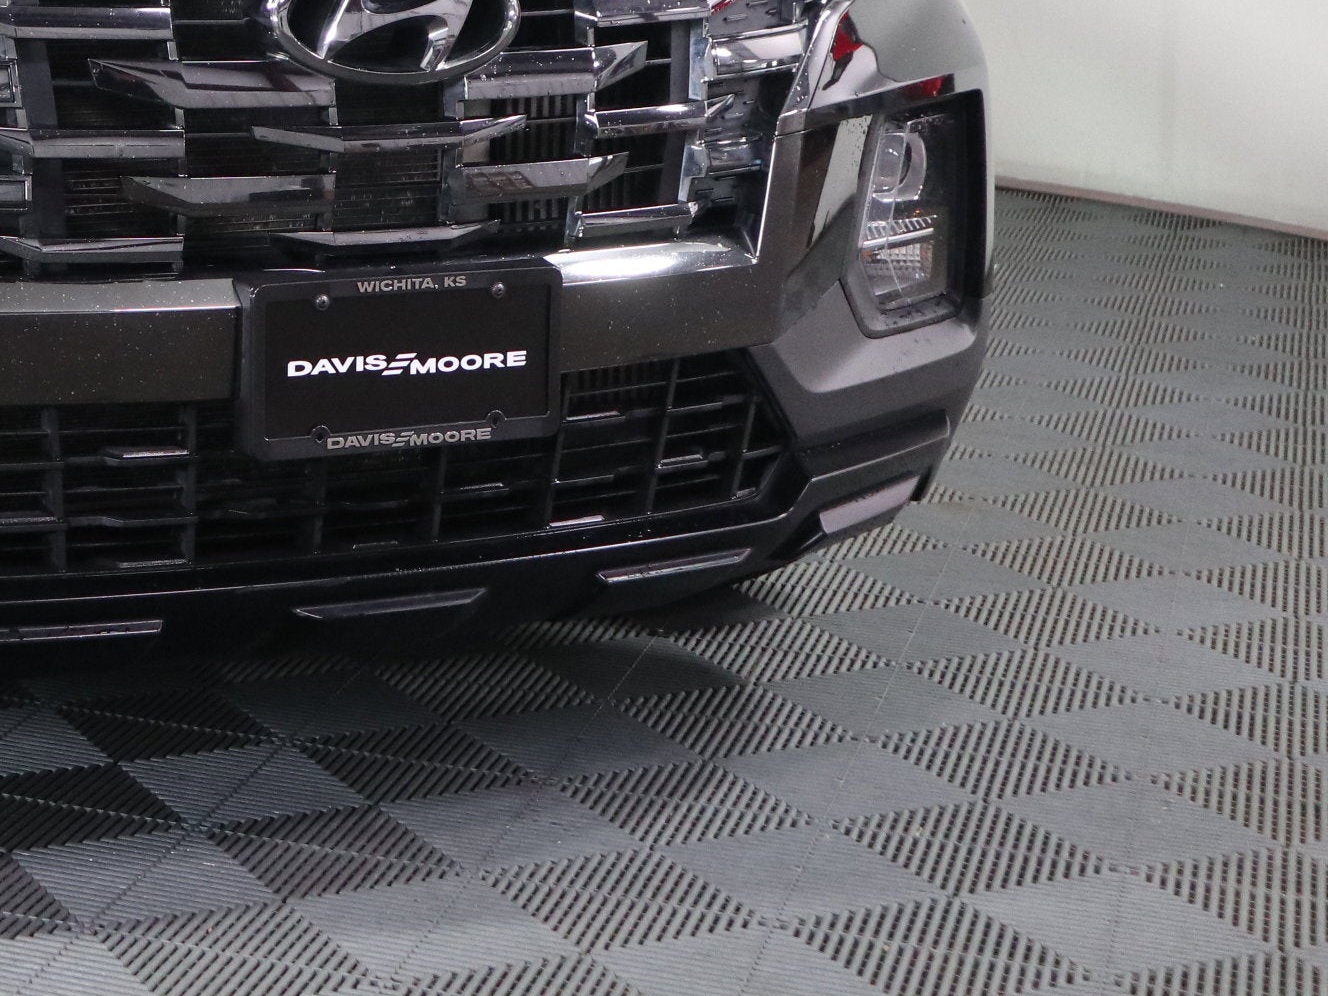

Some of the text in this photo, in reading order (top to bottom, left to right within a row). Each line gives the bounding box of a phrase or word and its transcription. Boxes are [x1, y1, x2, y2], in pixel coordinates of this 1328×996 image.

[357, 275, 467, 293] WICHITA, KS
[287, 350, 527, 377] DAVIS MOORE
[326, 428, 491, 450] DAVIS MOORE
